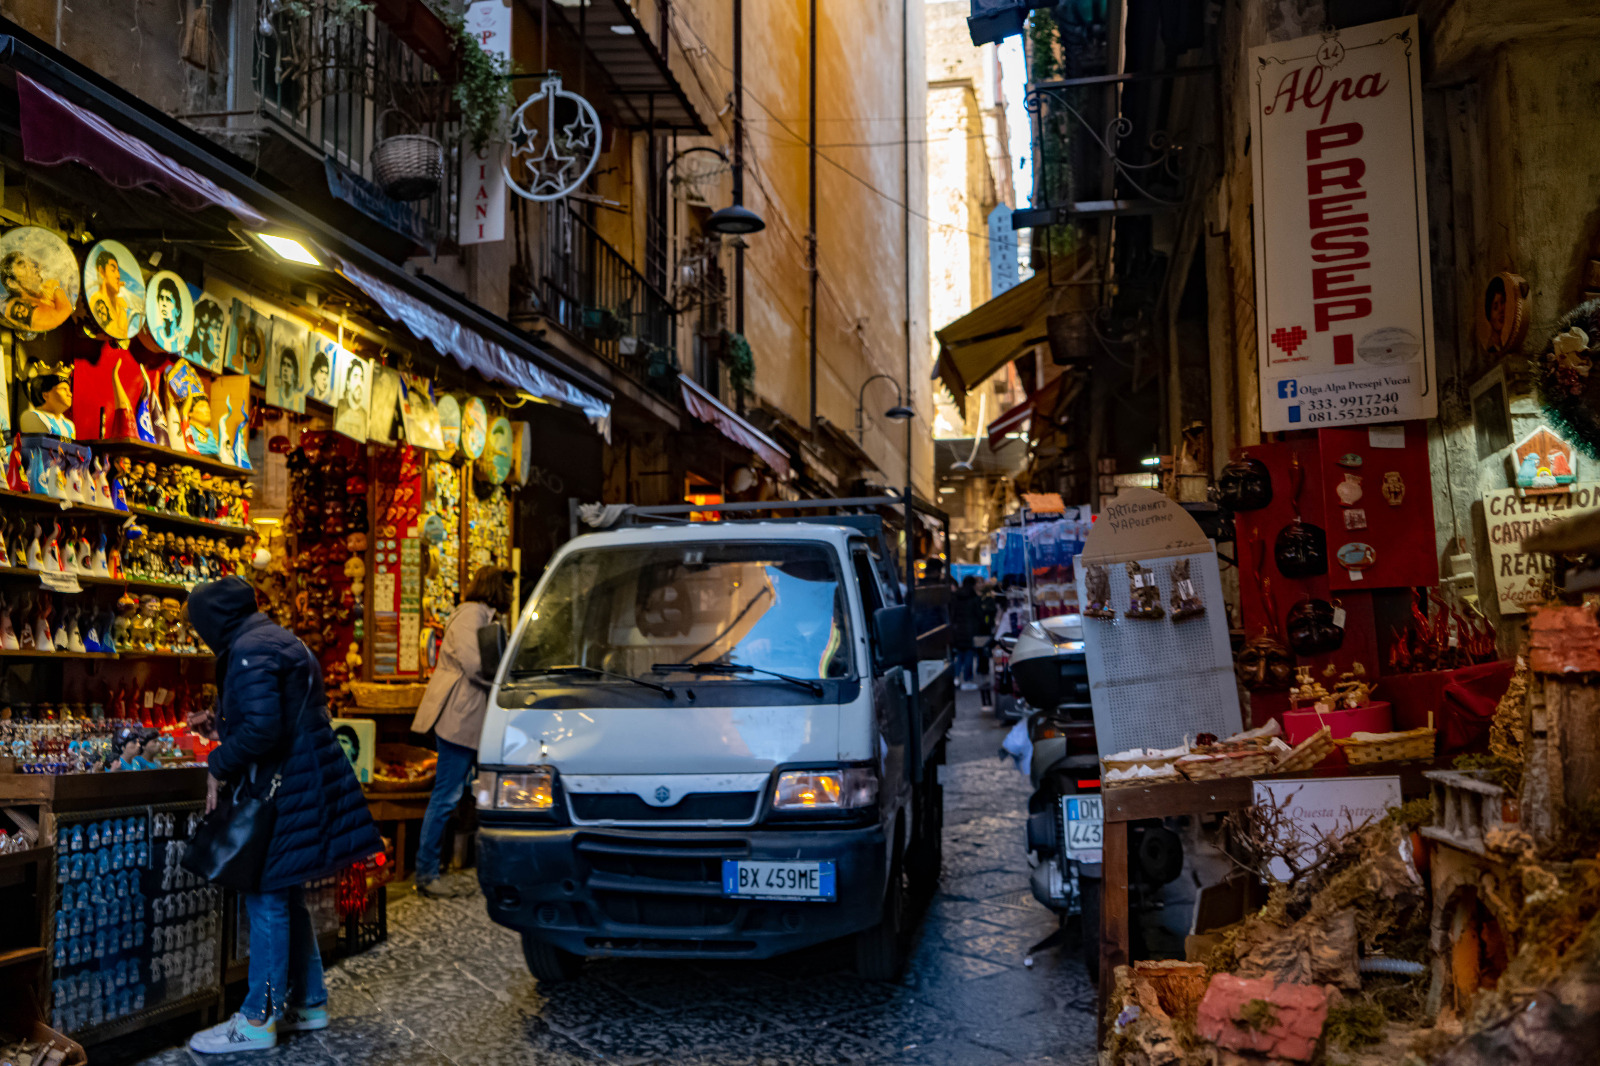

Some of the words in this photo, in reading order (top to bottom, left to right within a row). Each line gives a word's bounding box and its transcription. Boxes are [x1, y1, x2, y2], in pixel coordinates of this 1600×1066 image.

[1322, 45, 1340, 61] 14
[1264, 65, 1390, 125] Alpa
[1306, 122, 1372, 365] PRESEPI
[1299, 385, 1323, 396] Olga
[1325, 383, 1346, 394] Alpa
[1348, 380, 1382, 391] Presepi
[1308, 398, 1337, 411] 333.
[1340, 392, 1399, 407] 9917240
[1308, 404, 1399, 422] 081.5523204
[1106, 501, 1167, 520] ARTIGIANATO
[1109, 514, 1173, 534] NAPOLETANO
[1080, 800, 1100, 818] DM
[1292, 805, 1334, 819] Questa
[739, 868, 760, 888] BX
[765, 868, 819, 890] 459ME
